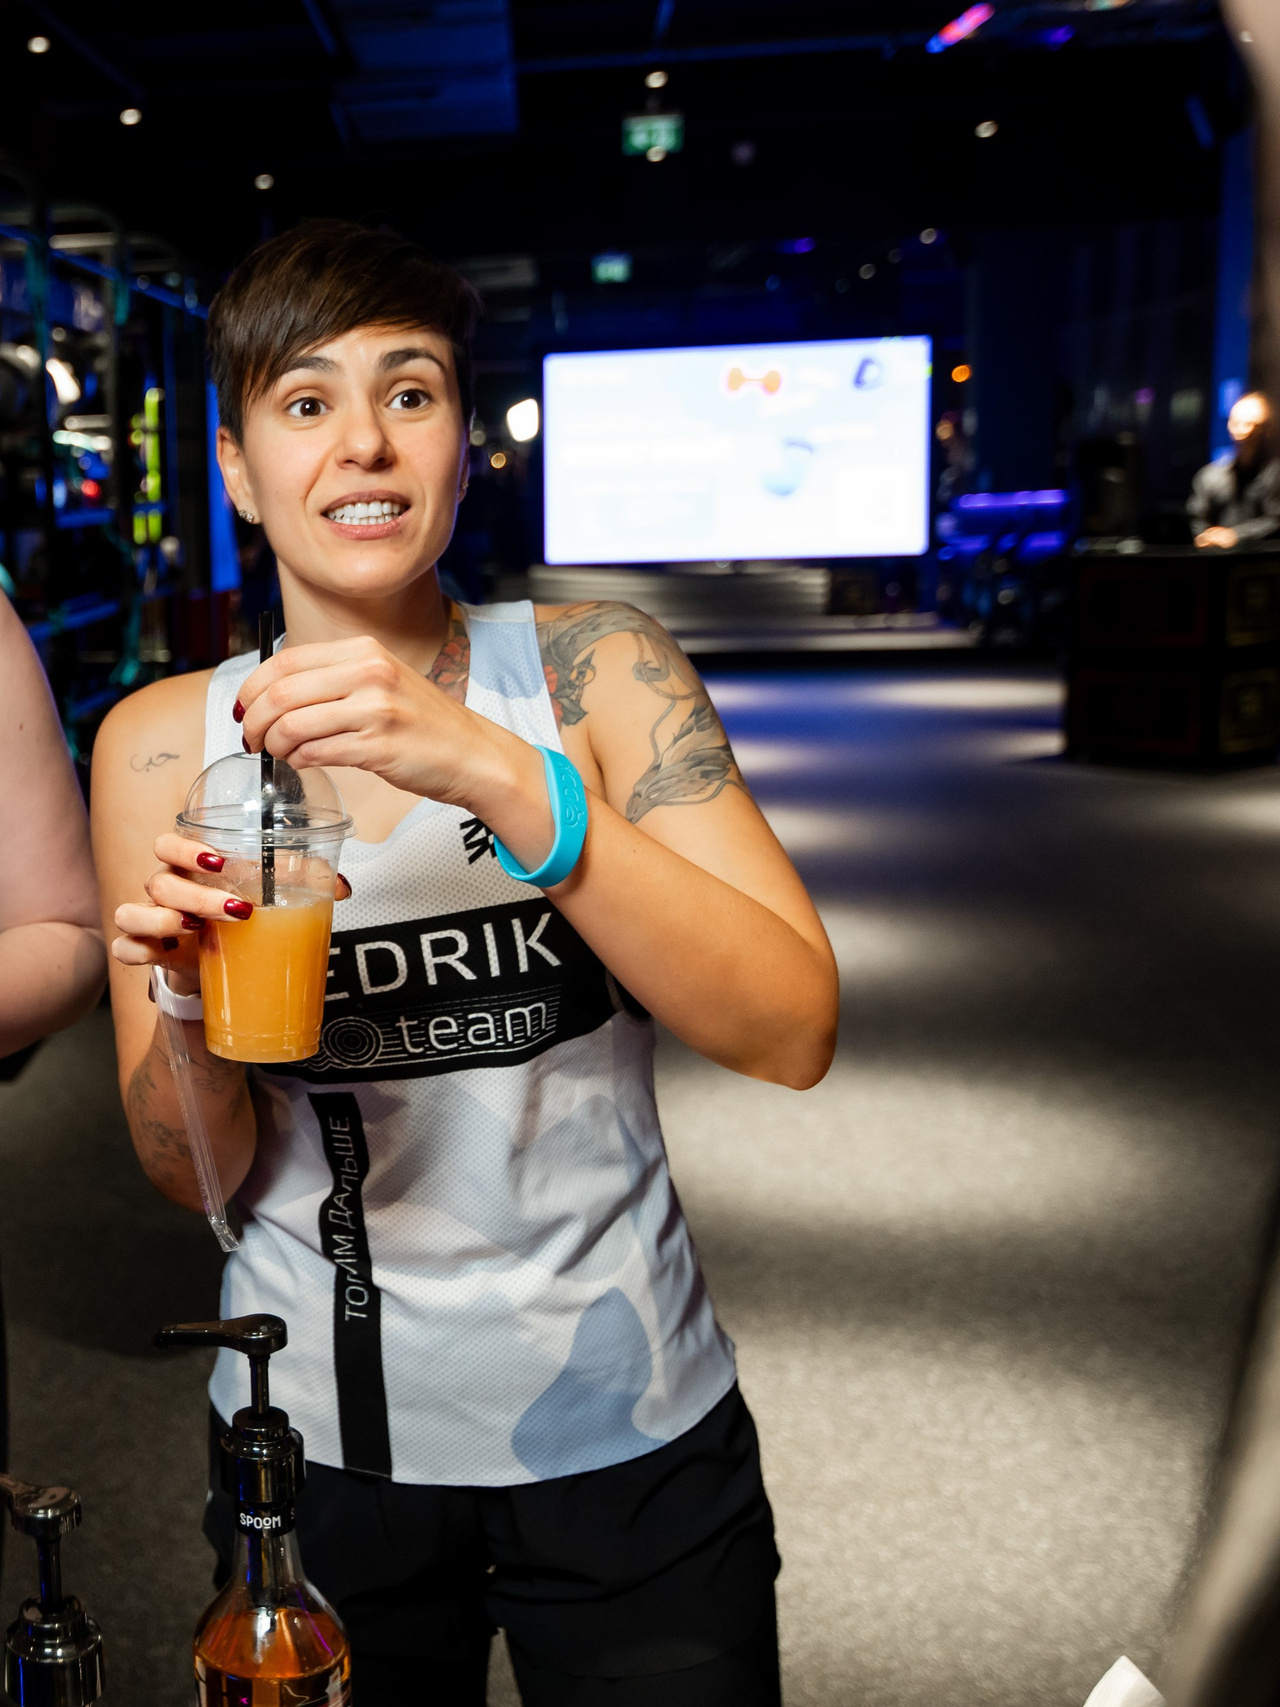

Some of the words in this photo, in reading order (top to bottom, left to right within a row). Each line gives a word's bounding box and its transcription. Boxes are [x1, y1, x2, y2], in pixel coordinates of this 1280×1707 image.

[394, 1001, 547, 1054] team
[328, 1116, 360, 1230] ДАЛЬШЕ
[239, 1512, 282, 1529] SPOOM
